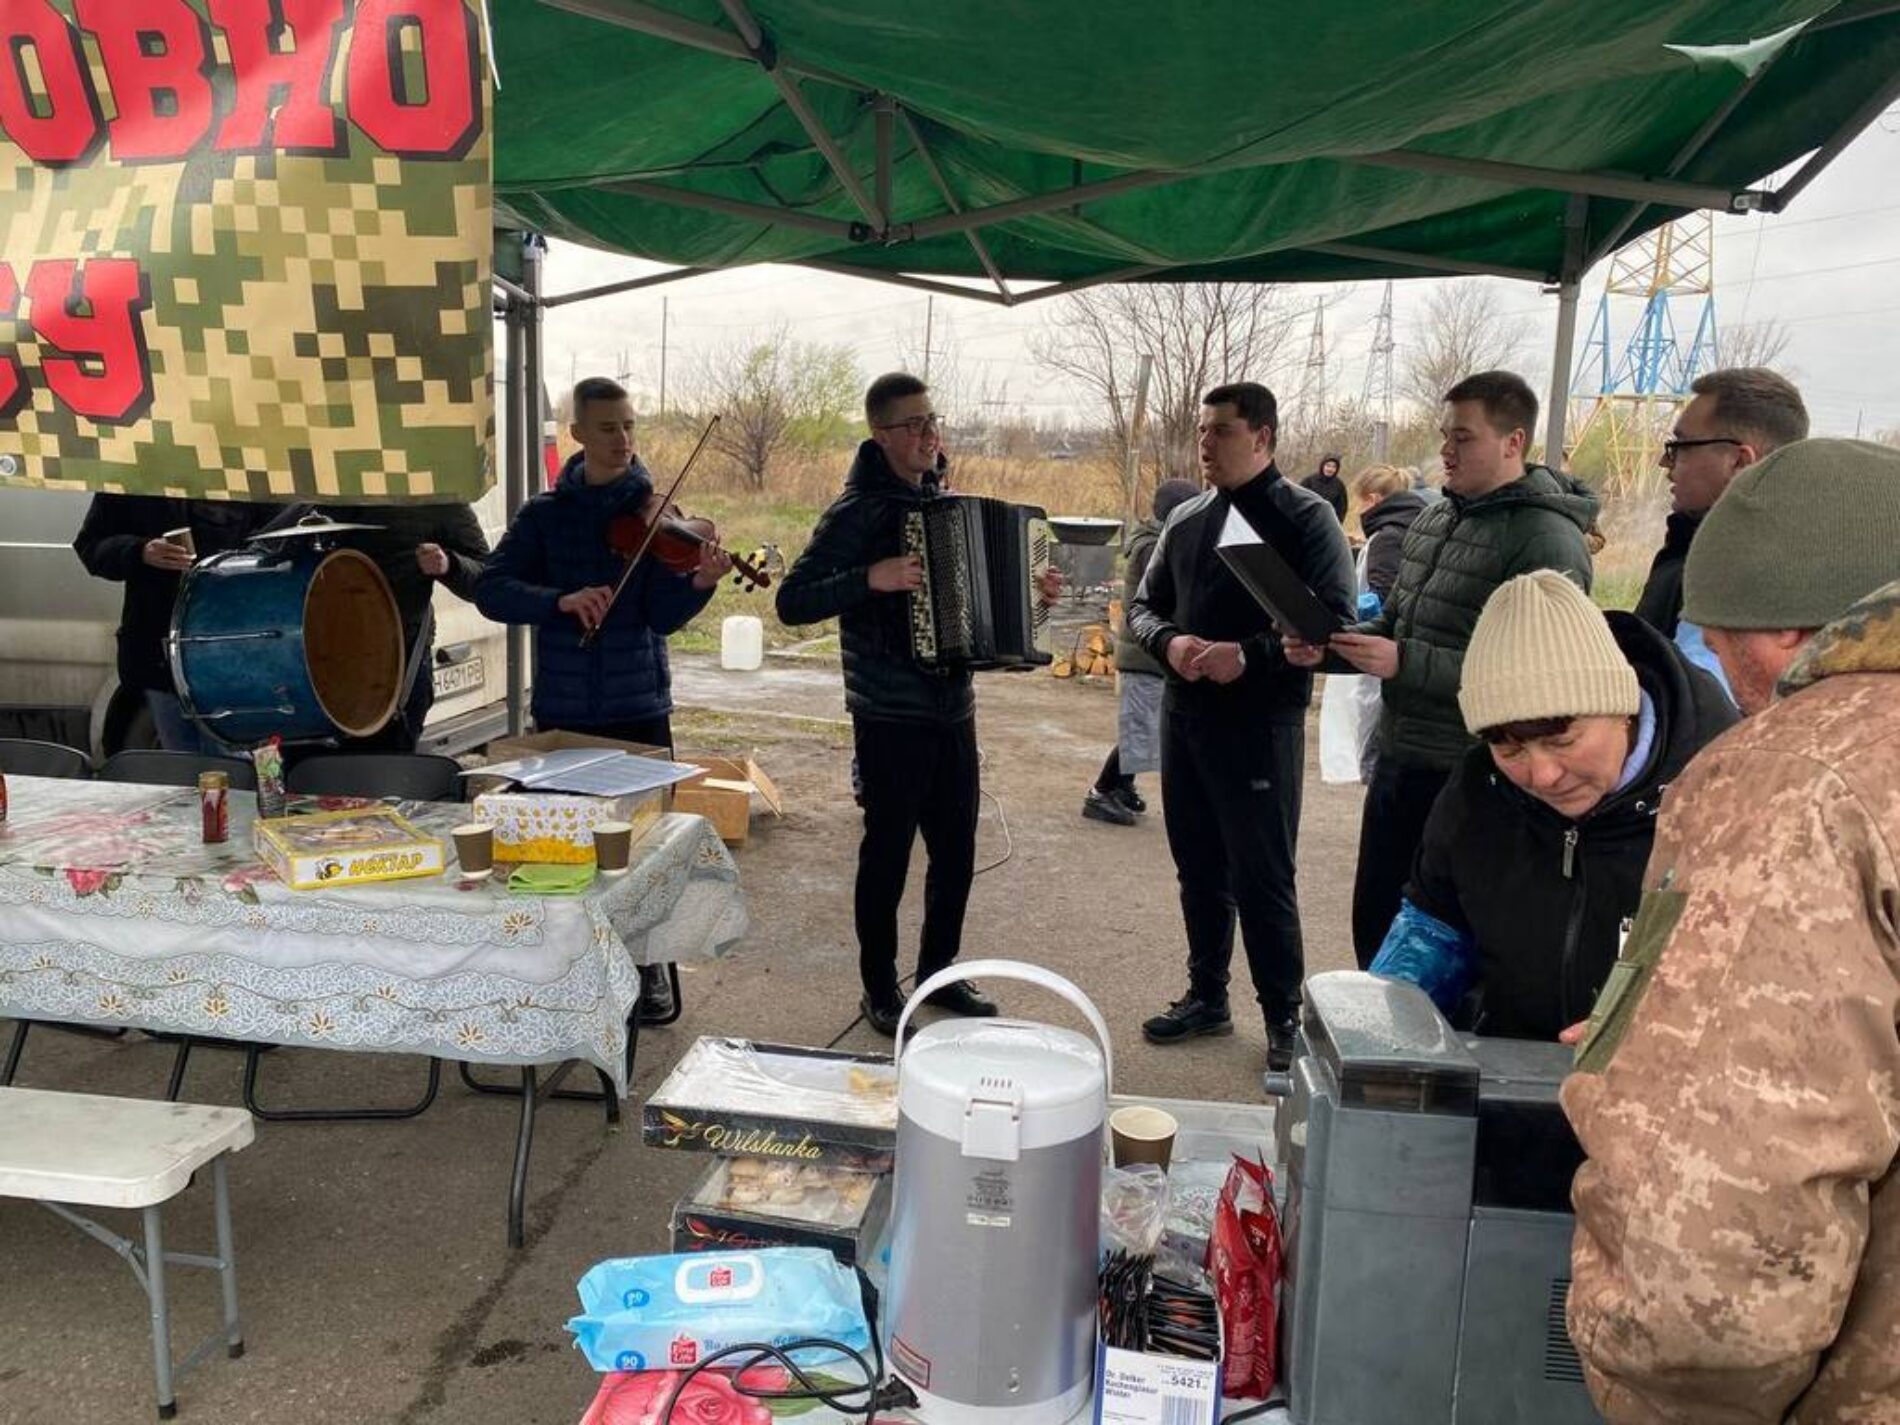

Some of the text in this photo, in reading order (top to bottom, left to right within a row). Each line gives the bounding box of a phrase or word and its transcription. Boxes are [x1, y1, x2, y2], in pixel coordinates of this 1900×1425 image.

[703, 1123, 823, 1159] Wilshanka
[621, 1356, 638, 1367] 90
[1171, 1376, 1202, 1389] 5421
